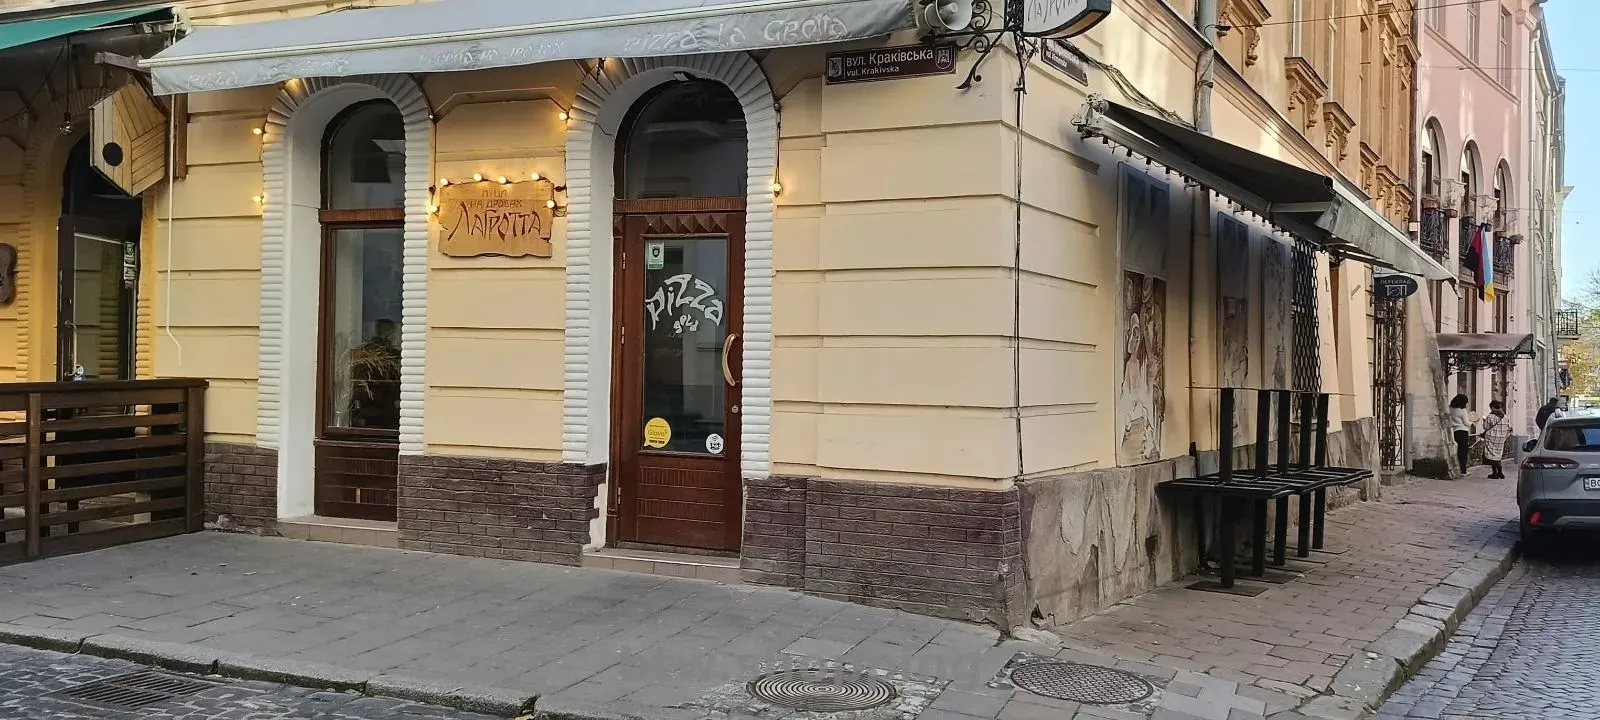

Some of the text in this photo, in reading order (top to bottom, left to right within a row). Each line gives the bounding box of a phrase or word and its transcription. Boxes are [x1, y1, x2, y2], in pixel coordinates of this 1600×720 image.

[869, 49, 934, 66] Краківська
[847, 66, 900, 77] vul. Krakivska
[470, 200, 483, 209] НА
